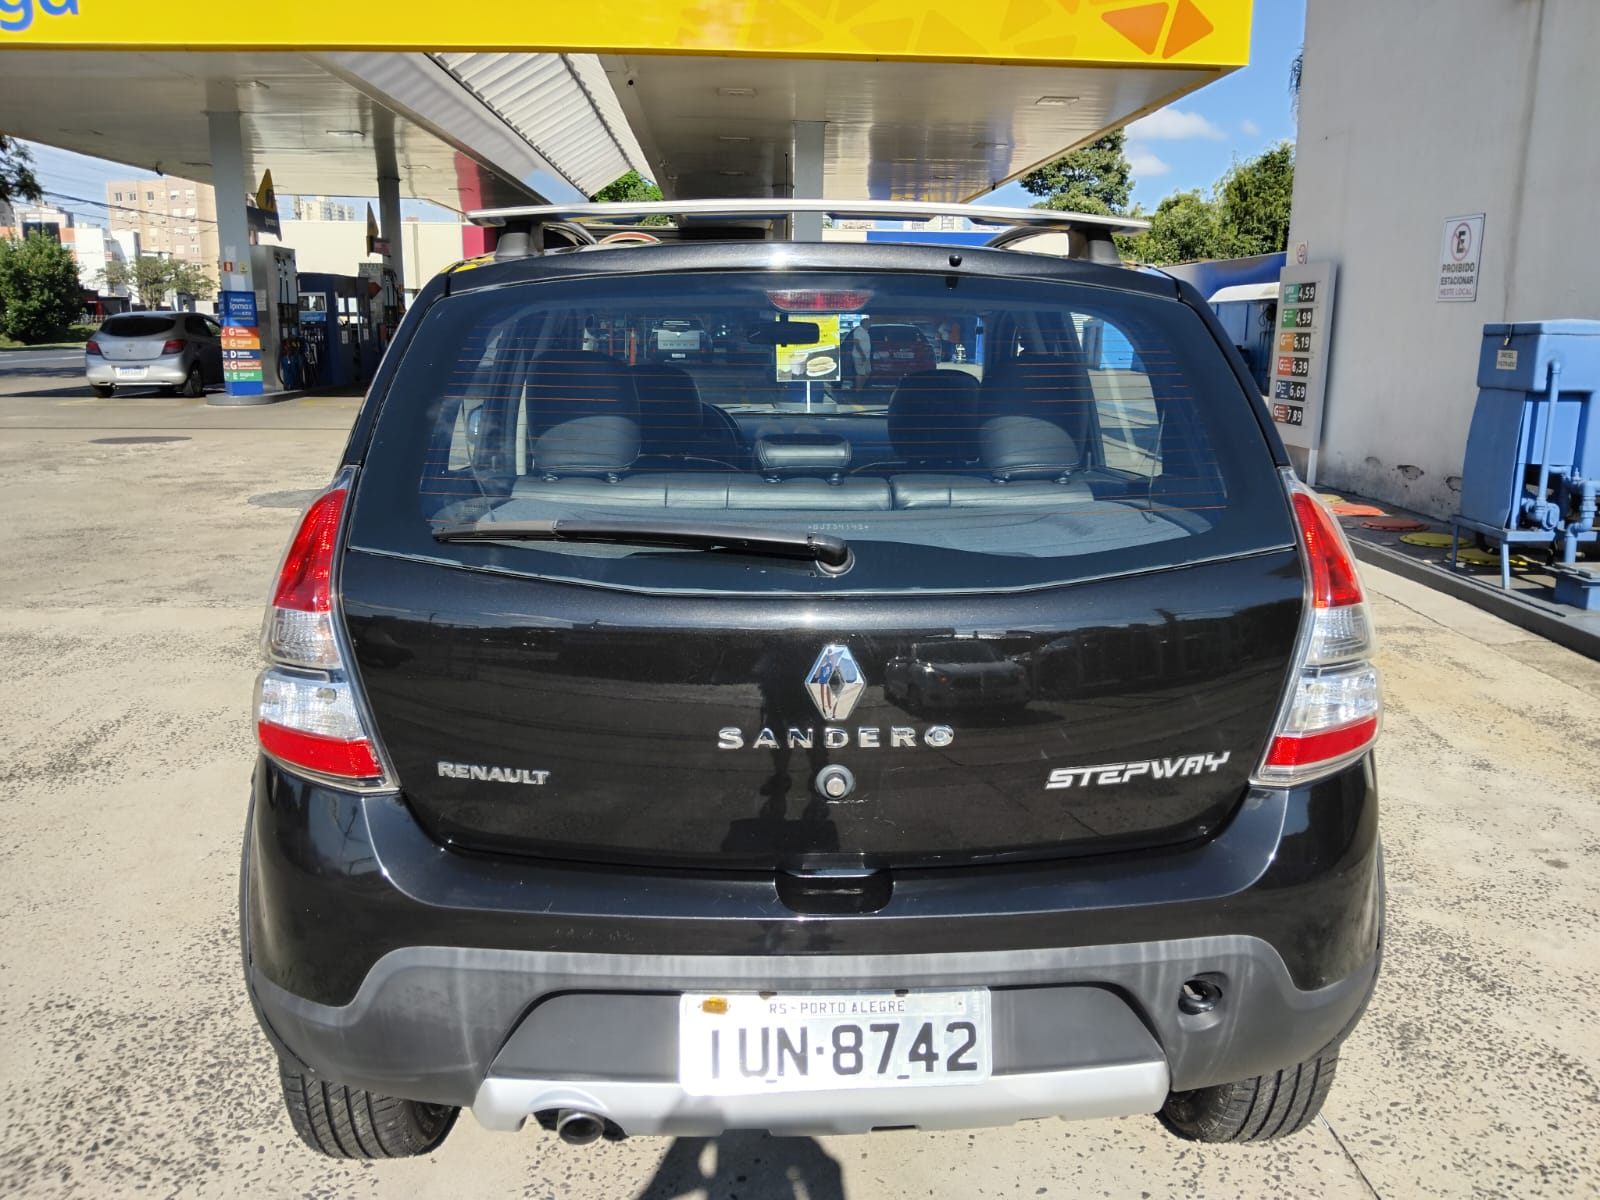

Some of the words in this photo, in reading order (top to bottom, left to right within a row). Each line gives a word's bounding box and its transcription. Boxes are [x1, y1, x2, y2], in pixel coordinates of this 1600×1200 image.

[1456, 230, 1466, 253] E
[1442, 263, 1475, 273] PROIBIDO
[1440, 276, 1474, 285] ESTACIONAR
[1299, 287, 1315, 300] 4,59
[1455, 287, 1472, 296] LOCAL
[1296, 311, 1312, 326] 4,99
[1294, 336, 1310, 349] 6,19
[1292, 361, 1308, 374] 6,39
[1290, 385, 1305, 398] 6,69
[1288, 409, 1302, 423] 7,89
[718, 725, 954, 749] SANDERO
[437, 761, 550, 785] RENAULT
[1045, 751, 1231, 790] STEPWAY
[851, 1000, 905, 1013] ALEGRE
